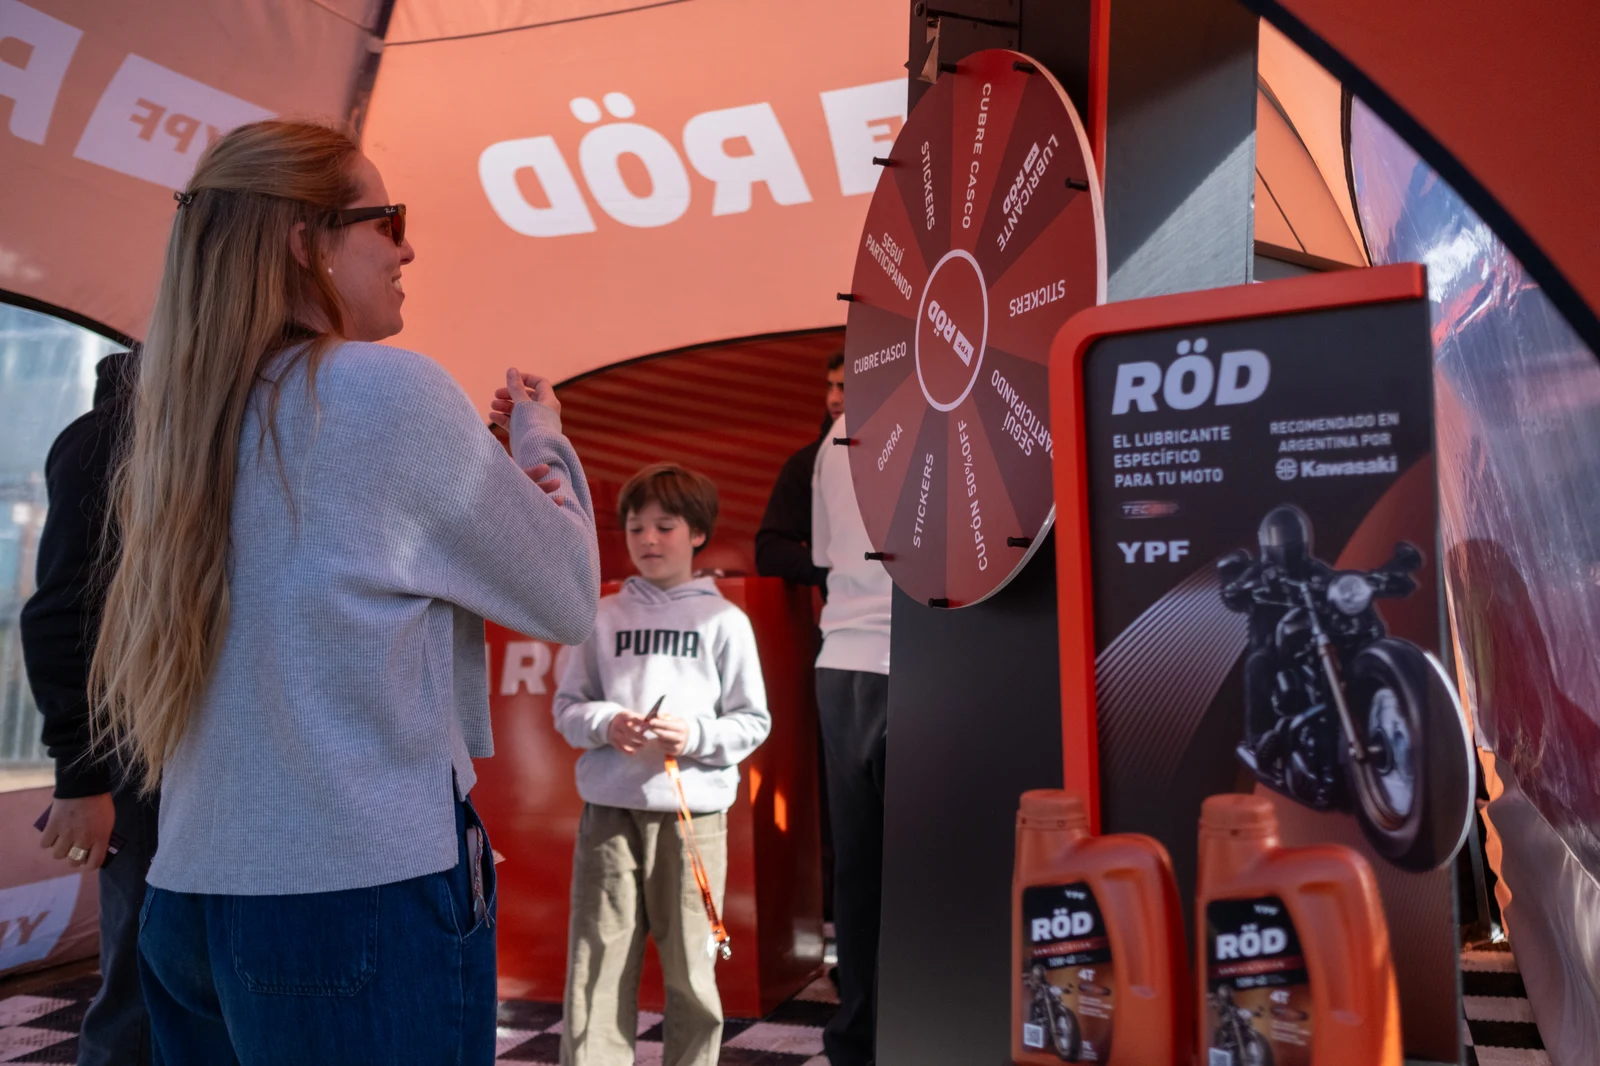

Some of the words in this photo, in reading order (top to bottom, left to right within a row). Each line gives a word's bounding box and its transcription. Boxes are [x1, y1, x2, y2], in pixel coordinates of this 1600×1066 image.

[973, 83, 991, 154] CUBRE
[921, 141, 935, 230] STICKERS
[962, 161, 980, 228] CASCO
[997, 134, 1058, 252] LUBRICANTE
[1003, 169, 1025, 214] RÖD
[865, 234, 912, 300] PARTICIPANDO
[881, 232, 904, 265] SEGUÍ
[1009, 279, 1066, 317] STICKERS
[928, 300, 957, 344] RÖD
[854, 352, 879, 374] CUBRE
[881, 341, 907, 365] CASCO
[1111, 338, 1271, 415] RÖD
[991, 369, 1054, 460] ARTICIPANDO
[1001, 411, 1034, 456] SEGUÍ
[1270, 415, 1373, 435] RECOMENDADO
[1377, 412, 1399, 427] EN
[877, 423, 903, 472] GORRA
[1113, 434, 1131, 448] EL
[1134, 425, 1231, 447] LUBRICANTE
[1278, 434, 1358, 453] ARGENTINA
[1361, 432, 1391, 446] POR
[1114, 448, 1200, 468] ESPECÍFICO
[1114, 473, 1153, 488] PARA
[1156, 471, 1176, 486] TU
[1180, 468, 1223, 484] MOTO
[1301, 456, 1398, 477] Kawasaki
[913, 453, 934, 548] STICKERS
[970, 500, 988, 571] CUPÓN
[1117, 540, 1190, 563] YPF
[615, 629, 699, 658] PUMA
[1031, 908, 1093, 941] RÖD
[1216, 923, 1287, 960] RÖD
